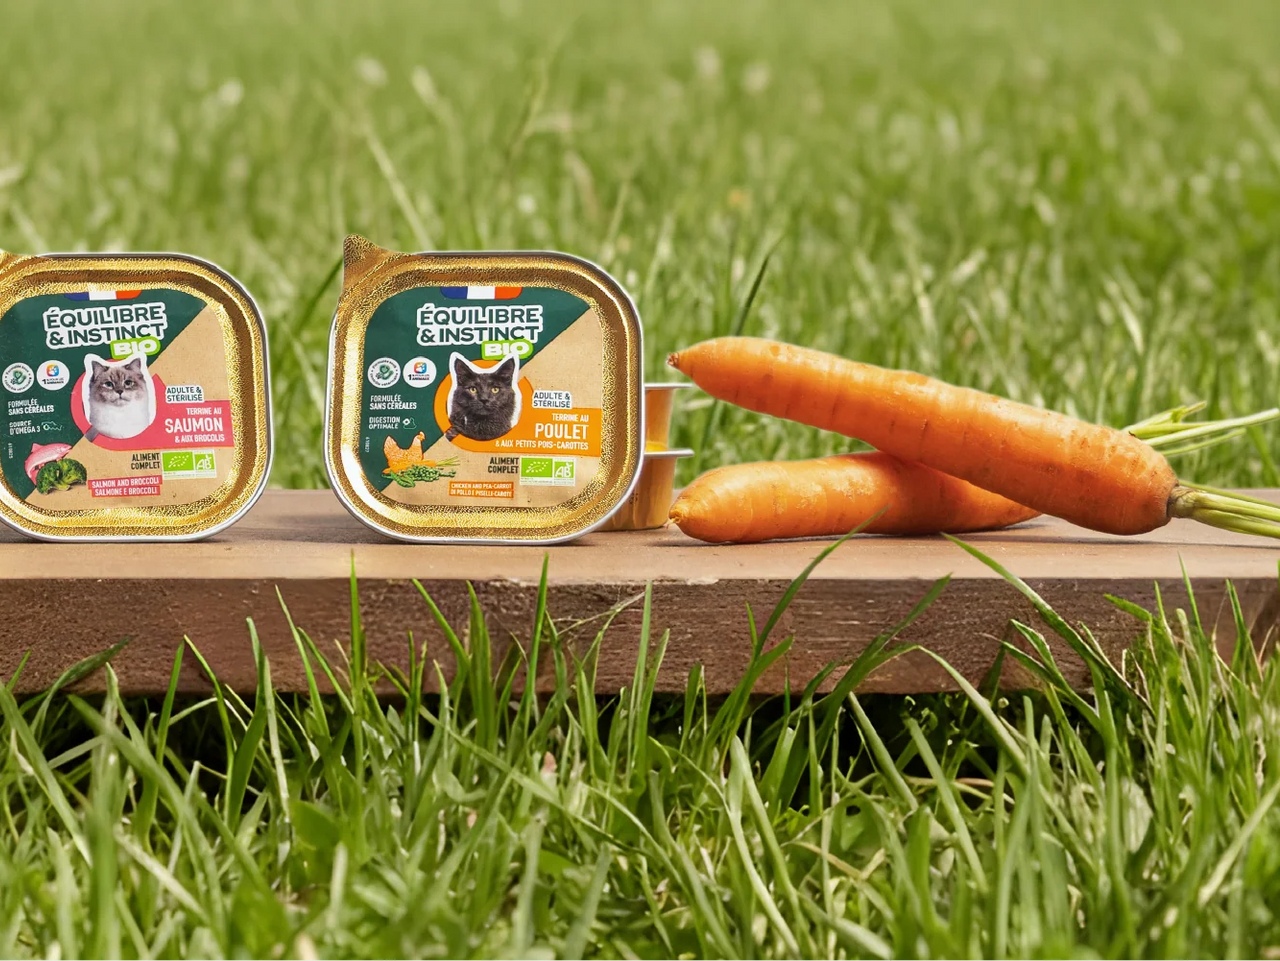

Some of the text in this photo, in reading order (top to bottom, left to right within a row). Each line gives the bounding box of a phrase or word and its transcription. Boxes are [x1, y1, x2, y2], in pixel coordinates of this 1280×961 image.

[46, 305, 163, 328] ÉQUILIBRE
[420, 306, 539, 325] ÉQUILIBRE
[49, 323, 164, 346] & INSTINCT
[420, 326, 539, 343] & INSTINCT
[113, 339, 158, 356] BIO
[484, 342, 530, 357] BIO
[370, 394, 401, 402] FORMULÉE
[534, 392, 562, 400] ADULTE
[8, 398, 38, 408] FORMULÉE
[369, 401, 417, 410] SANS CÉRÉALES
[8, 404, 54, 416] SANS CÉRÉALES
[186, 407, 212, 415] TERRINE
[369, 416, 400, 424] DIGESTION
[552, 413, 579, 422] TERRINE
[165, 417, 223, 433] SAUMON
[535, 423, 589, 440] POULET
[194, 434, 225, 442] BROCOLIS
[515, 440, 536, 448] PETITS
[538, 441, 588, 450] POIS-CAROTTES
[132, 453, 159, 461] ALIMENT
[490, 457, 519, 465] ALIMENT
[131, 461, 160, 470] COMPLET
[488, 466, 519, 474] COMPLET
[91, 477, 159, 488] SALMON AND BROCCOLI
[95, 488, 122, 496] SALMONE
[128, 487, 157, 495] BROCCOLI
